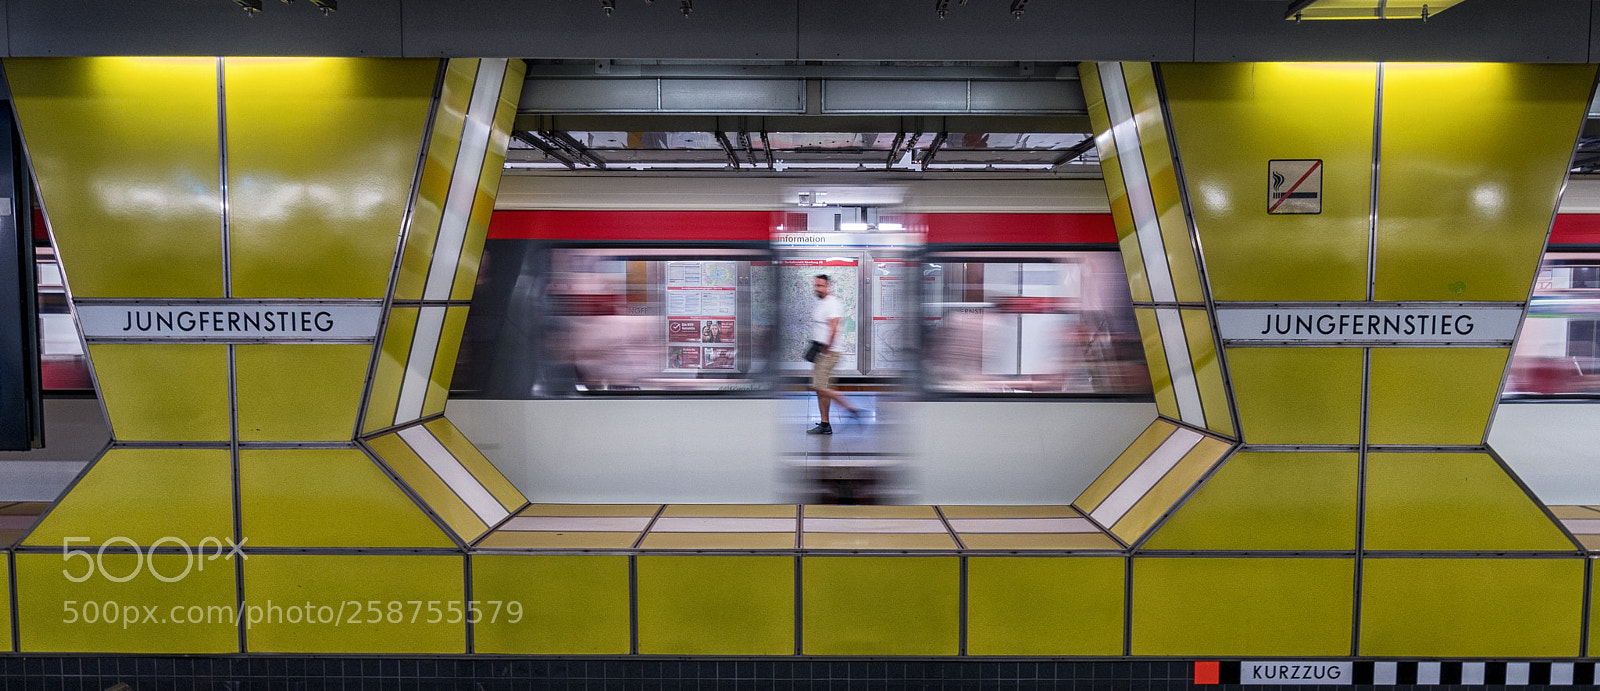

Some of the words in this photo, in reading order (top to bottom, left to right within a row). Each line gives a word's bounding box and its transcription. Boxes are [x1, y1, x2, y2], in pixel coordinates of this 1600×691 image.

[777, 234, 826, 243] Information
[122, 310, 335, 333] JUNGFERNSTIEG
[1261, 313, 1475, 336] JUNGFERNSTIEG
[1252, 664, 1342, 680] KURZZUG
